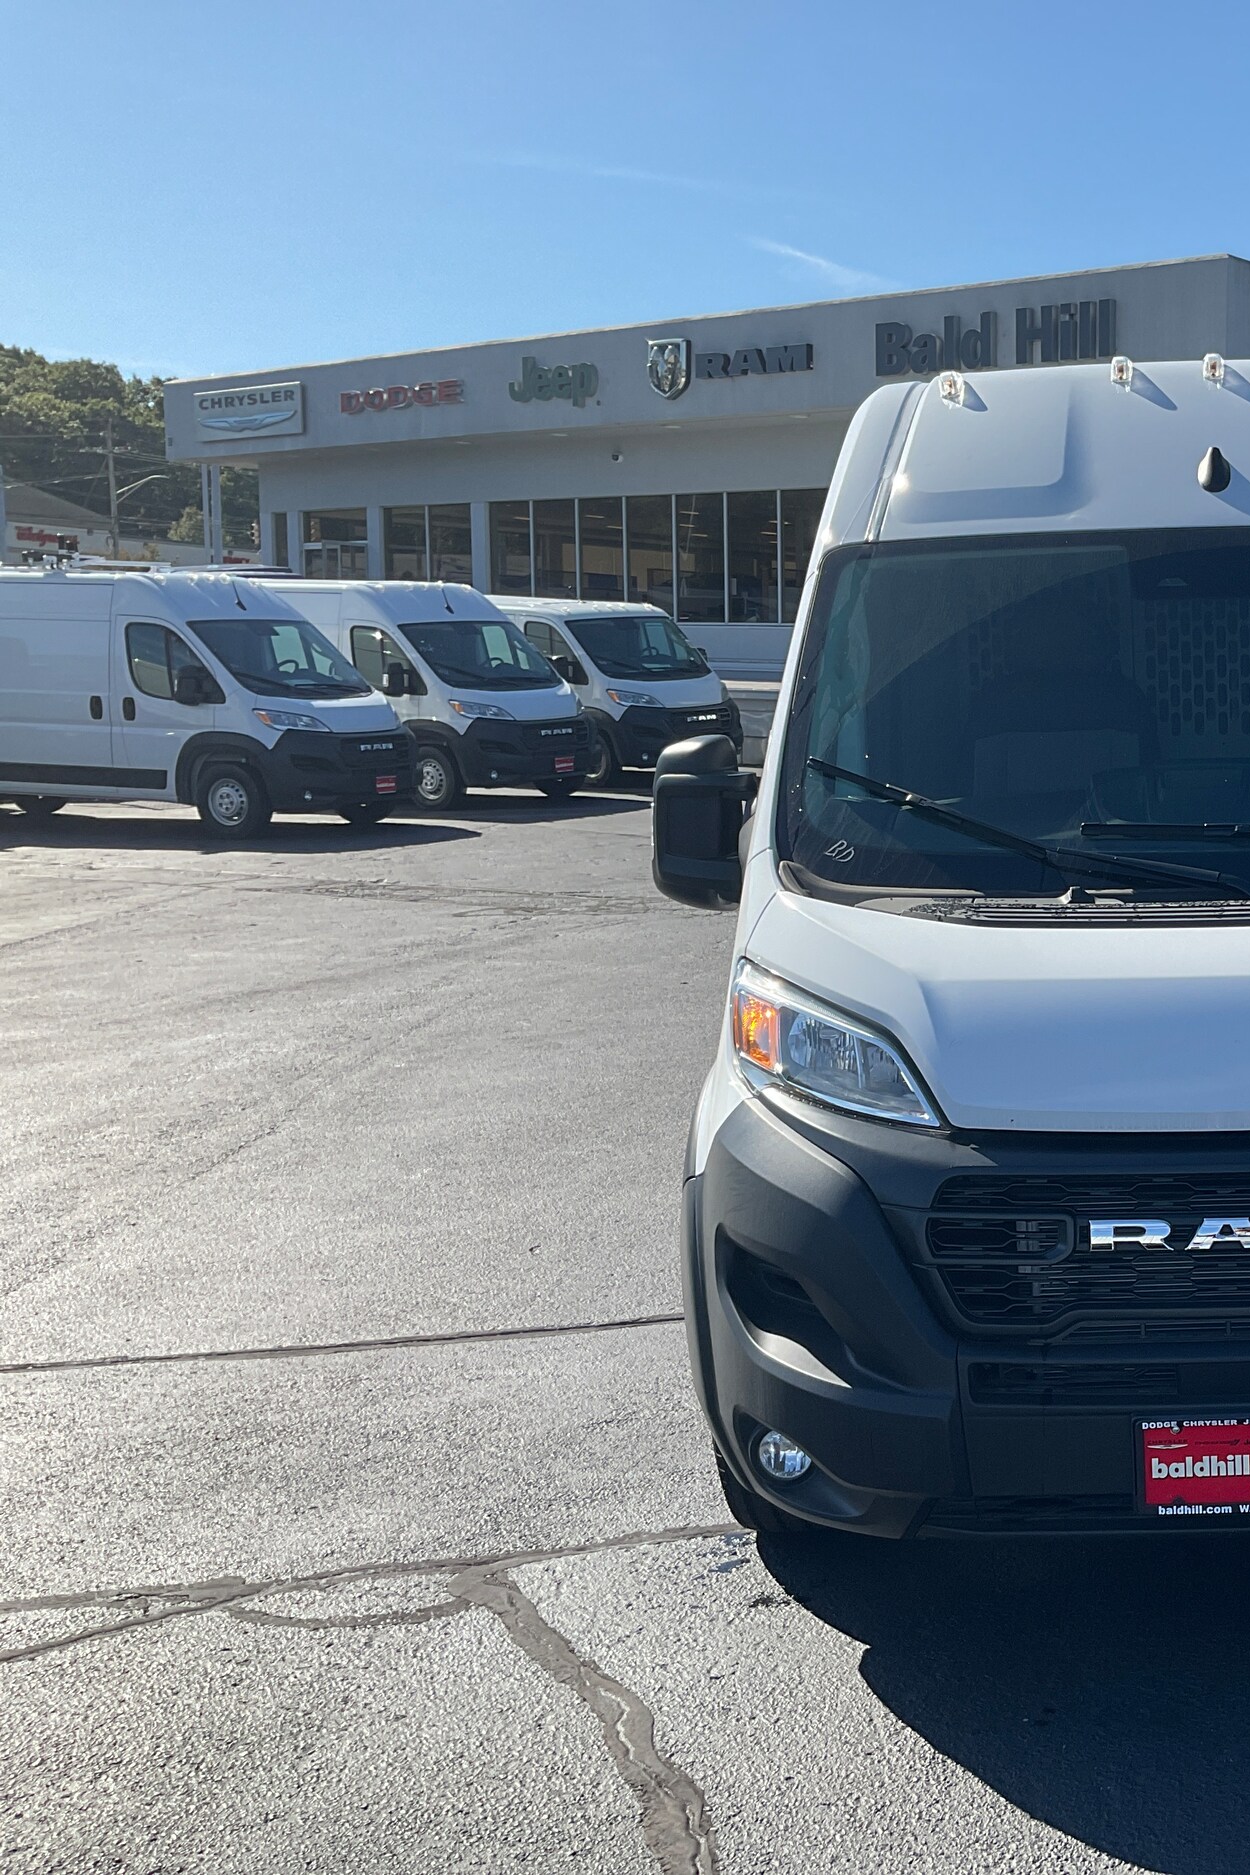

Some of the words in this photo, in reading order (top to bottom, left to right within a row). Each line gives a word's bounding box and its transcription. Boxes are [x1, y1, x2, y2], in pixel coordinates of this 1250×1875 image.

[875, 311, 997, 376] Bald
[1016, 299, 1116, 364] Hill
[695, 343, 813, 379] RAM
[340, 379, 465, 414] DODGE
[508, 356, 600, 408] Jeep
[198, 390, 295, 410] CHRYSLER
[1142, 1421, 1178, 1430] DODGE
[1182, 1419, 1238, 1427] CHRYSLER
[1158, 1504, 1232, 1515] baldhill.com
